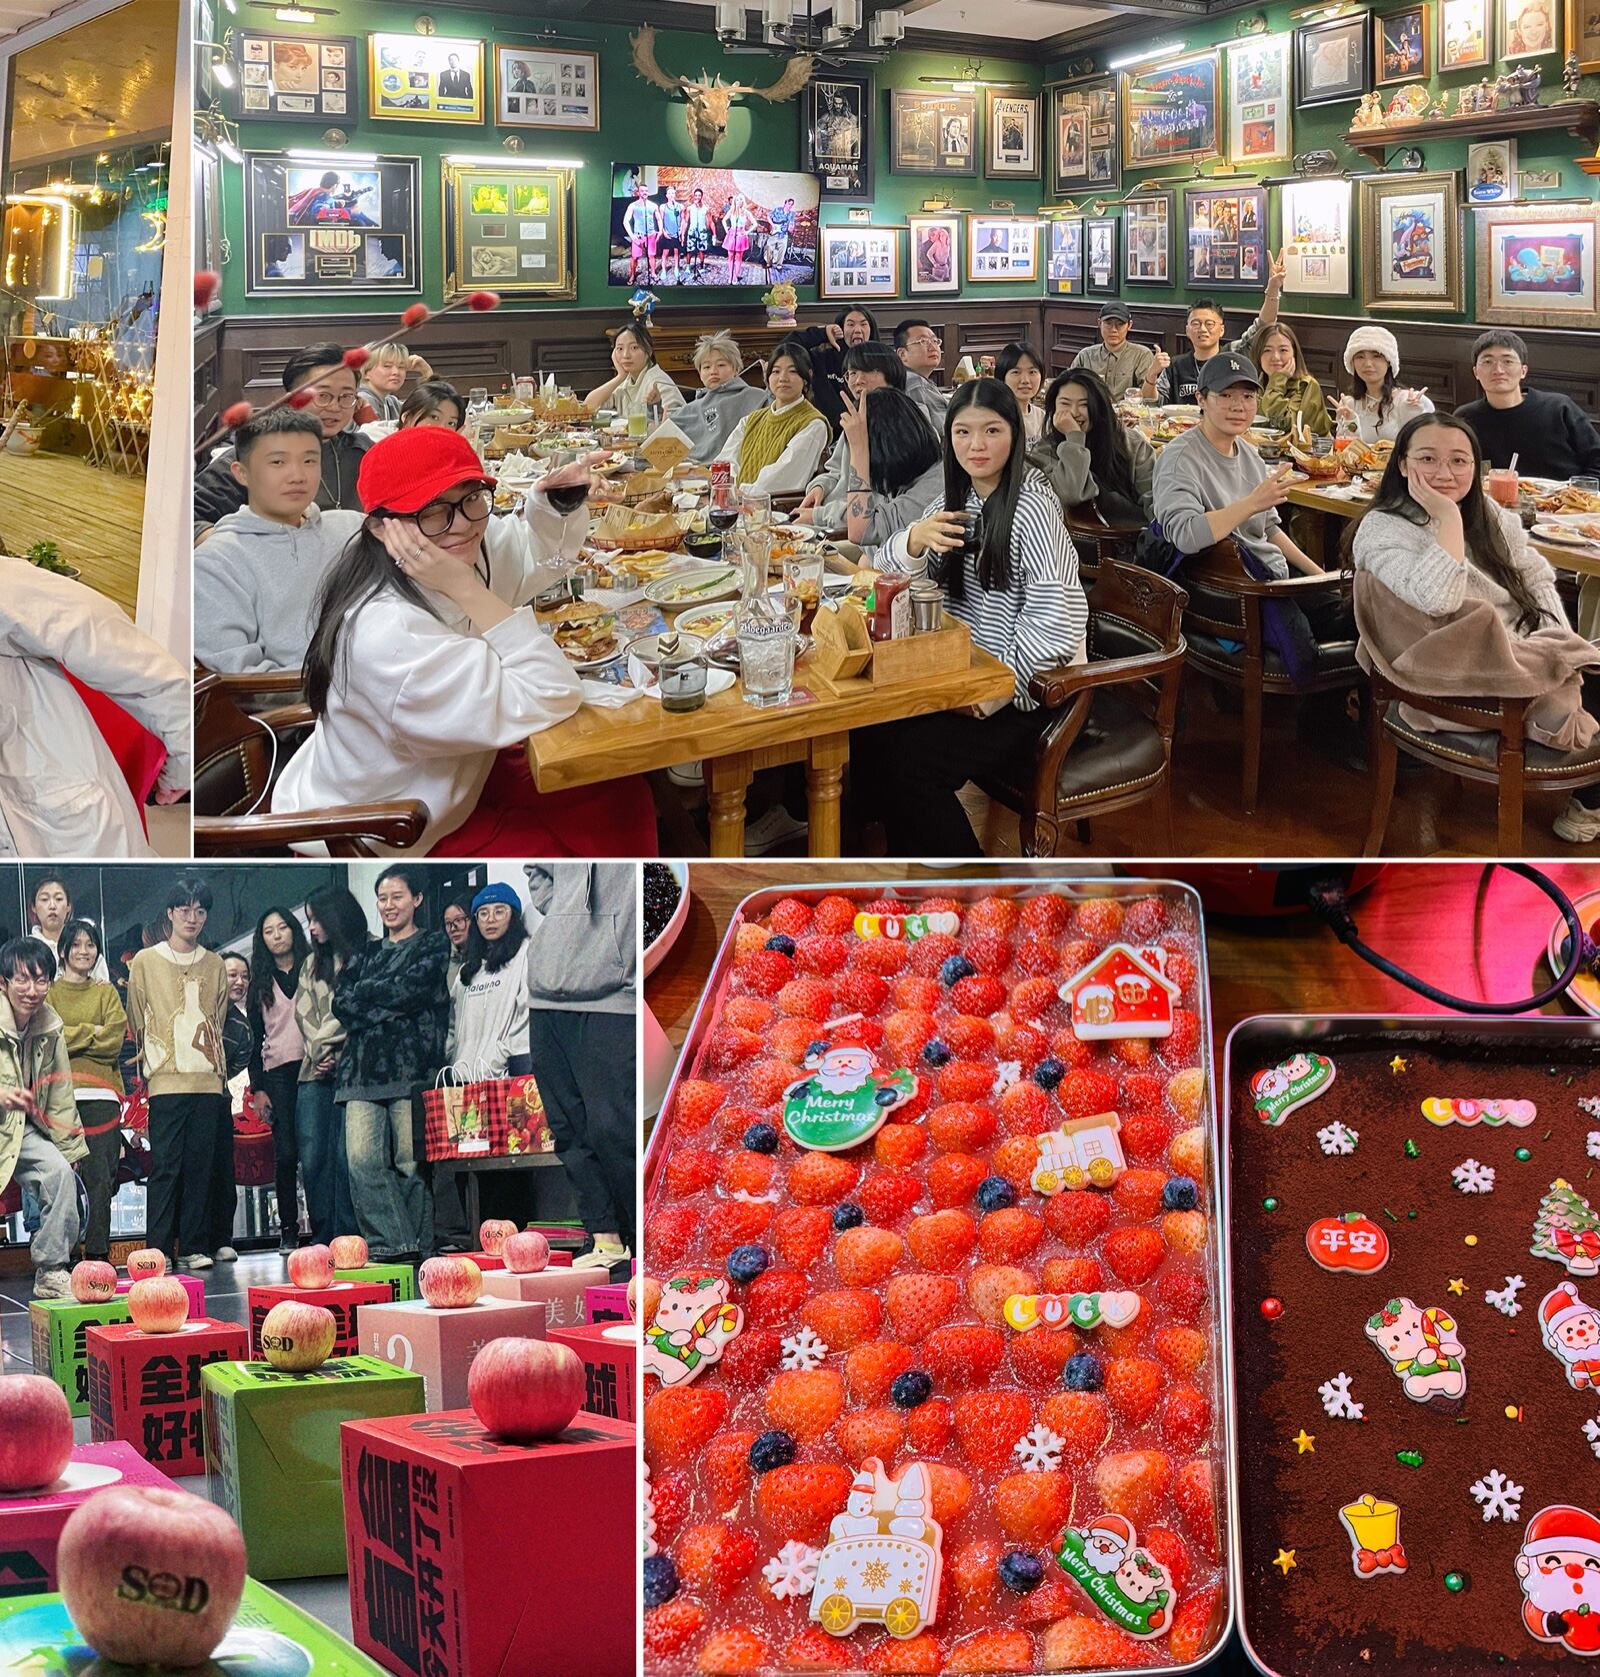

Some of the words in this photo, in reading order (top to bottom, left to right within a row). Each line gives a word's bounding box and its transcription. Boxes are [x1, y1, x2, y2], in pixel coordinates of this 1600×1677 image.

[818, 163, 859, 171] AQUAMAN
[309, 230, 361, 251] IMDb
[1230, 360, 1240, 370] LA
[1266, 1093, 1290, 1113] Merry
[1290, 1067, 1326, 1096] Christmas
[805, 1095, 855, 1111] Merry
[787, 1110, 876, 1125] Christmas
[1320, 1228, 1377, 1254] 平安
[137, 1261, 157, 1270] SOD
[88, 1280, 109, 1292] SOD
[1012, 1299, 1125, 1322] LUCK
[262, 1335, 294, 1352] SOD
[357, 1446, 422, 1677] 盲盒
[117, 1564, 209, 1613] SOD
[1061, 1548, 1092, 1578] Merry
[1090, 1577, 1142, 1625] Christmas
